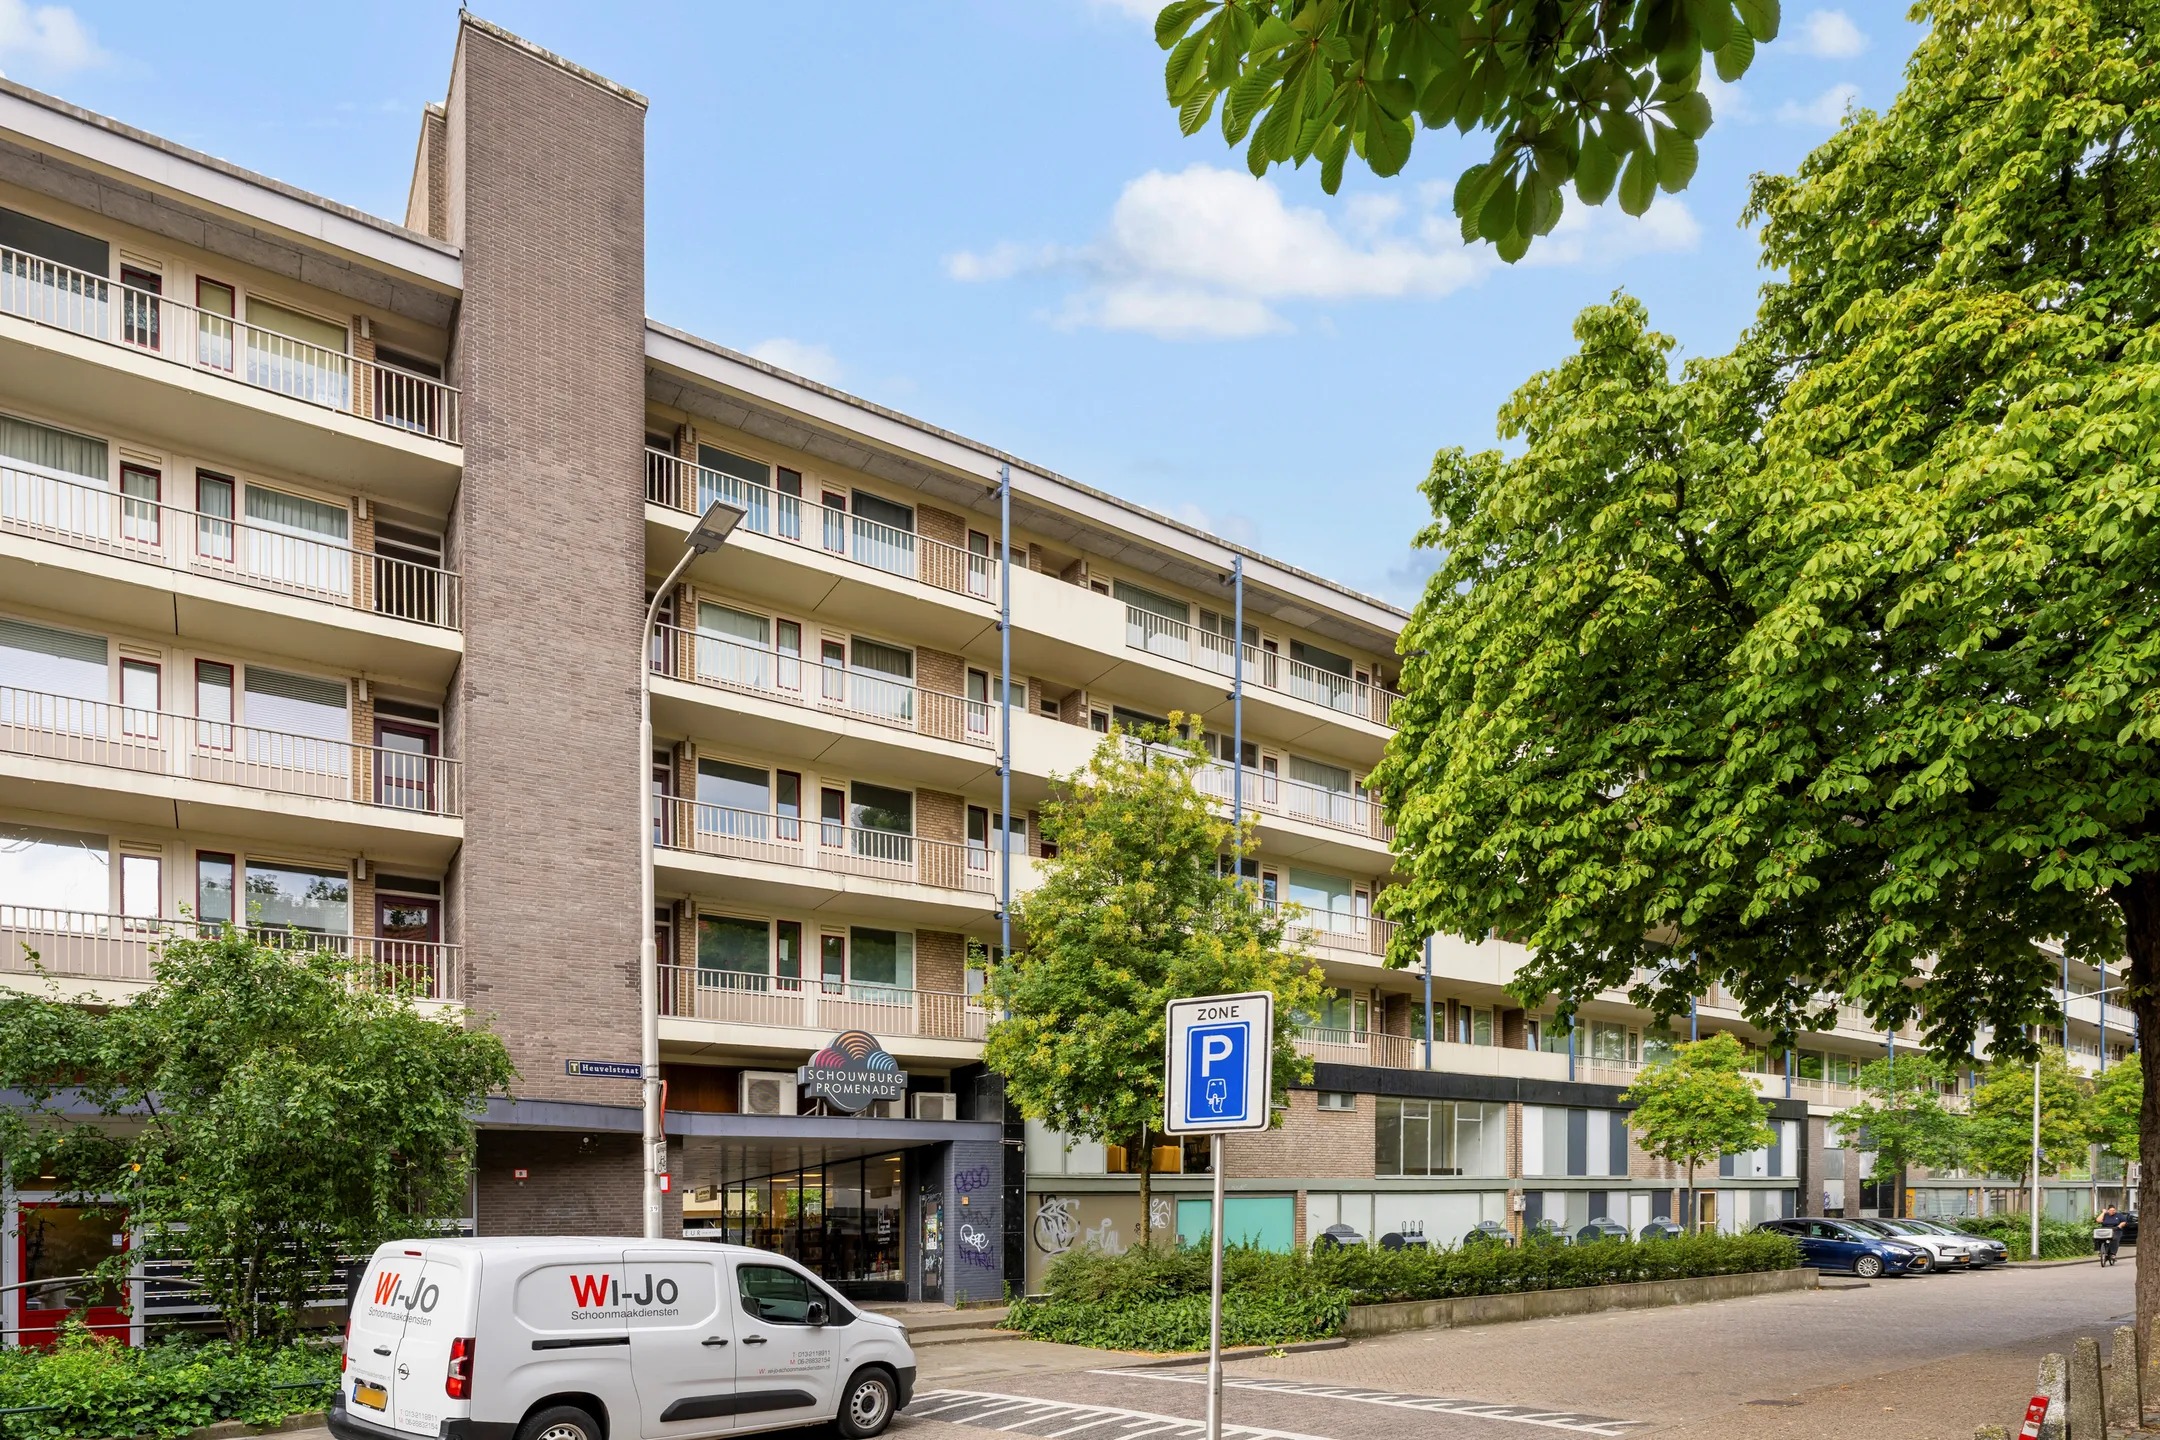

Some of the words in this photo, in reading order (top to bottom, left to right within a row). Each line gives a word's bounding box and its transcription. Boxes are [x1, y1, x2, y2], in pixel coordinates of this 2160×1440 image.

[1197, 1006, 1239, 1021] ZONE
[1202, 1034, 1233, 1078] P
[582, 1064, 639, 1075] Heuvelstraat
[808, 1069, 904, 1084] SCHOUWBURG
[816, 1083, 896, 1096] PROMENADE
[571, 1308, 679, 1320] Schoonmaakdiensten
